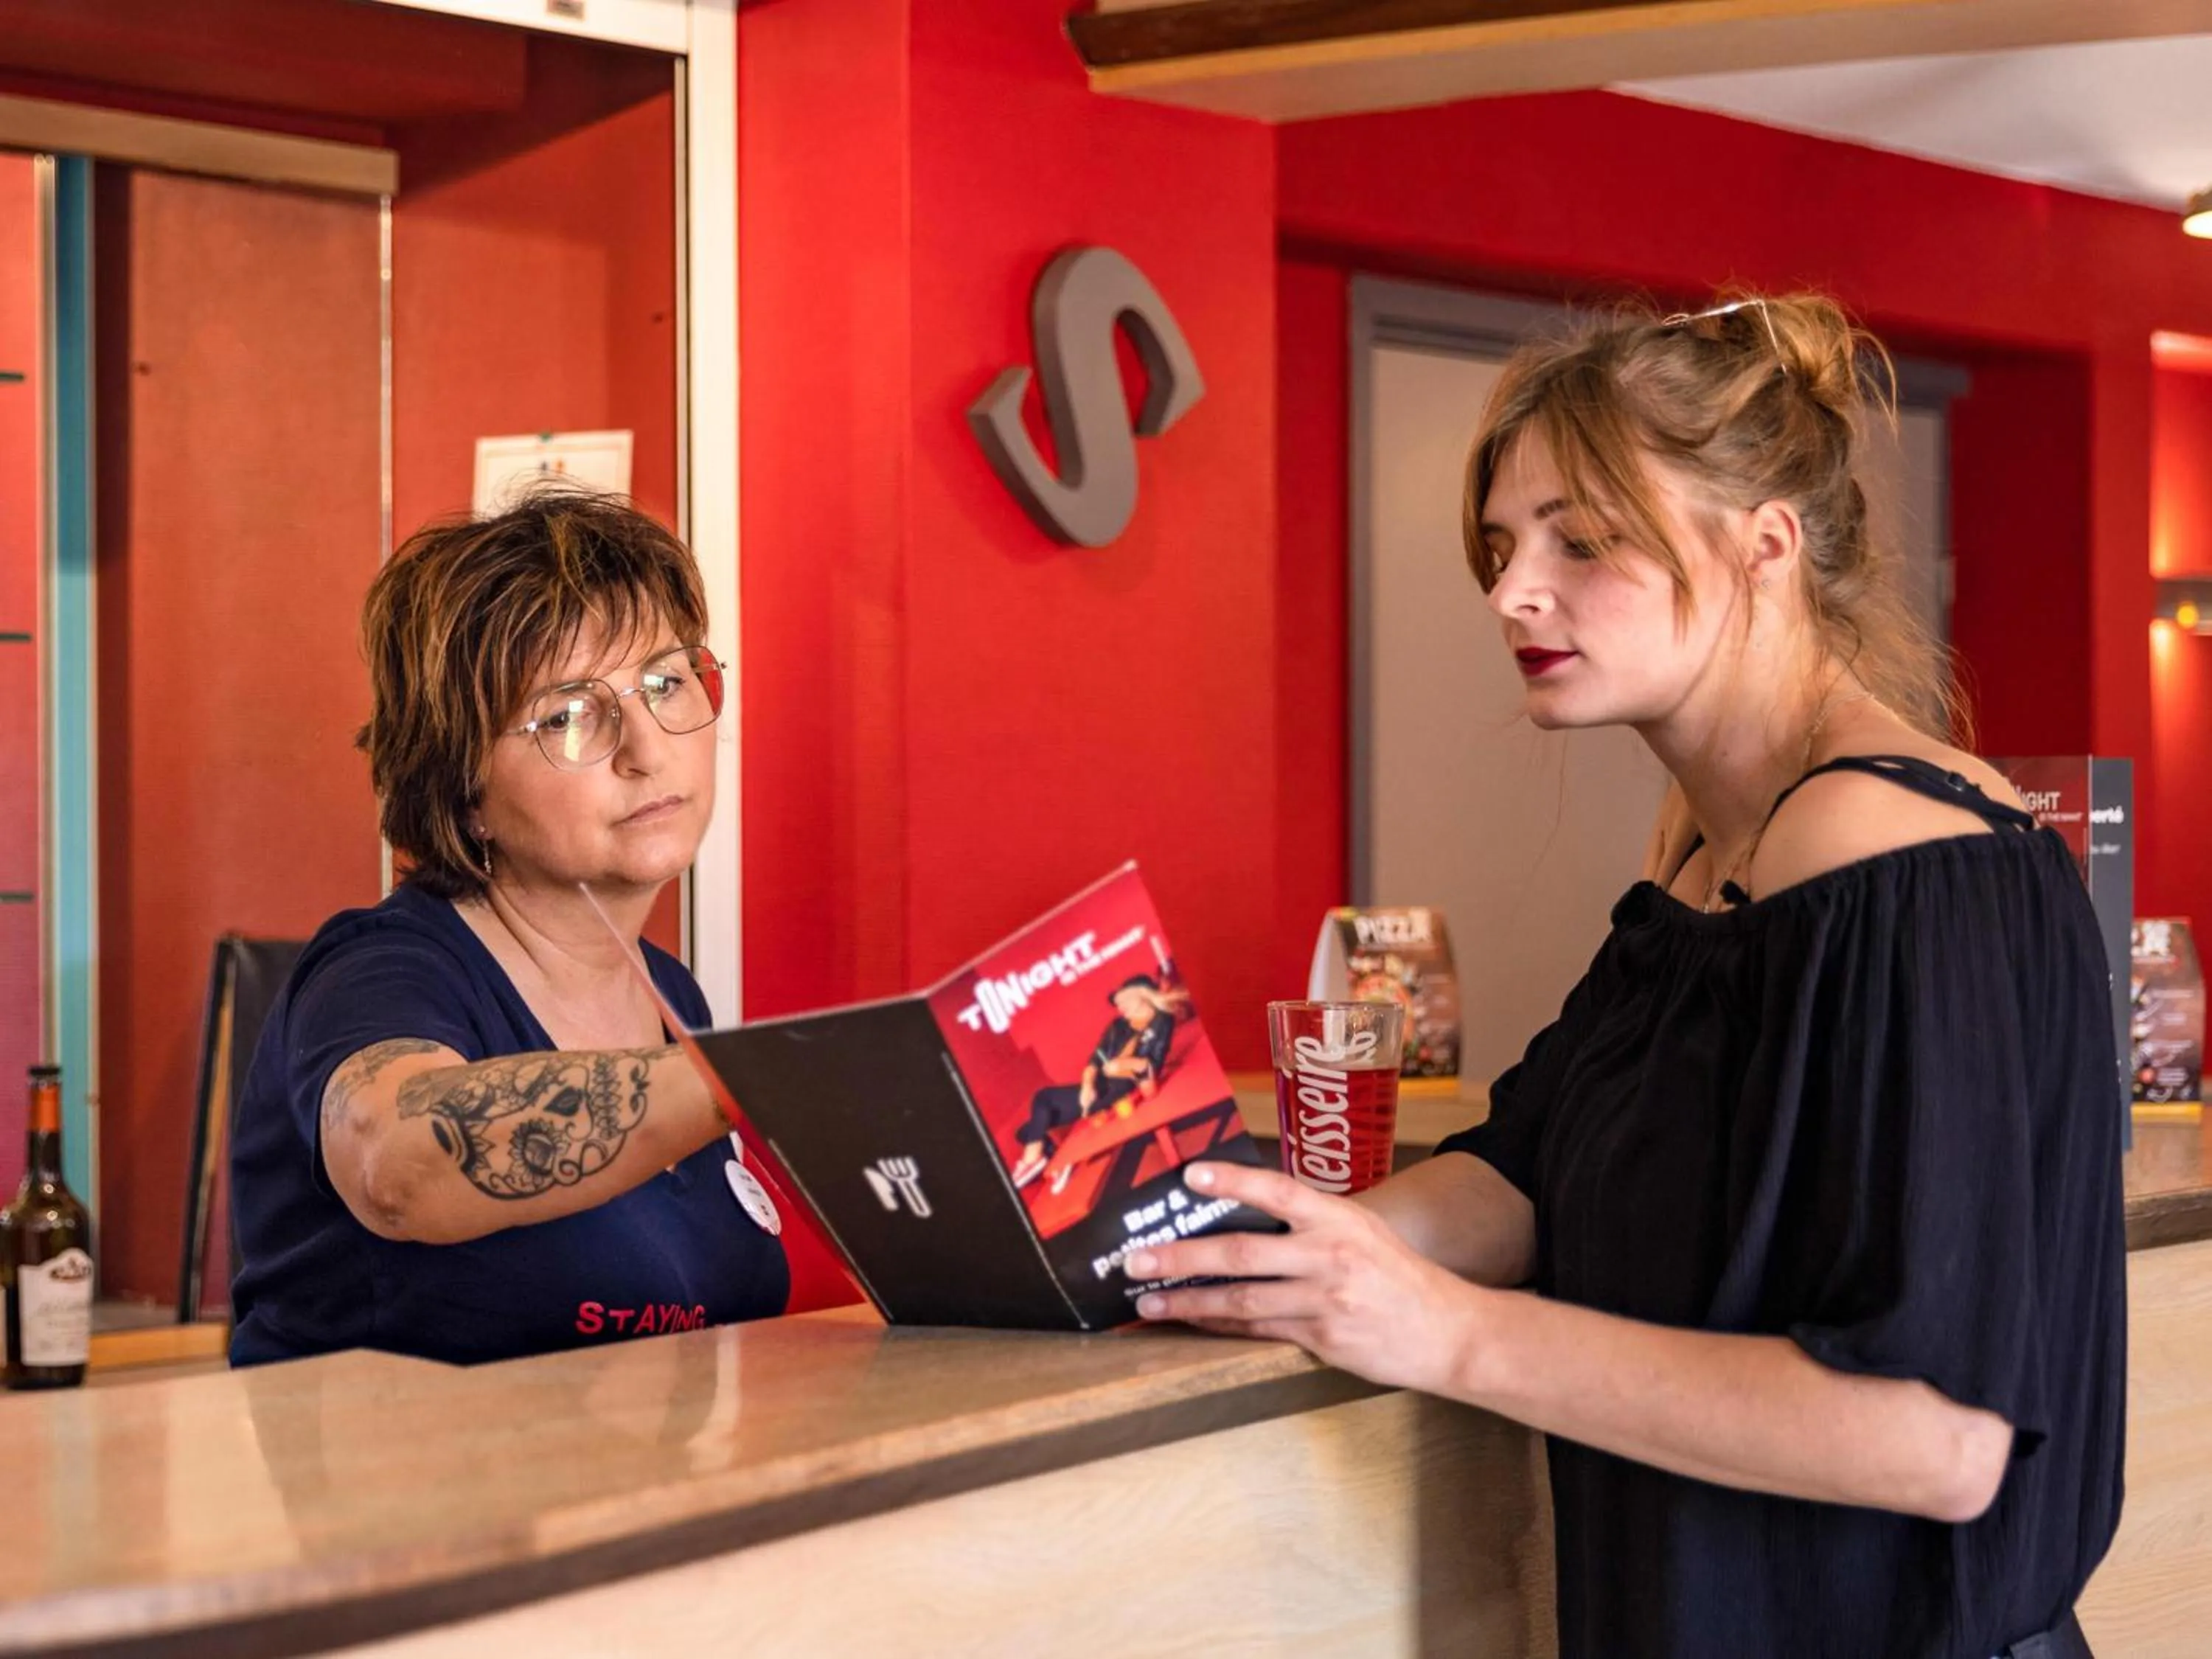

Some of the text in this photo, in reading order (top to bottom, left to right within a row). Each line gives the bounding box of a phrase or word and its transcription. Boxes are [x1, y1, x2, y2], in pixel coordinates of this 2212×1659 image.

[967, 246, 1206, 548] S
[1123, 1199, 1166, 1233] Bar
[575, 1301, 706, 1334] STAYING
